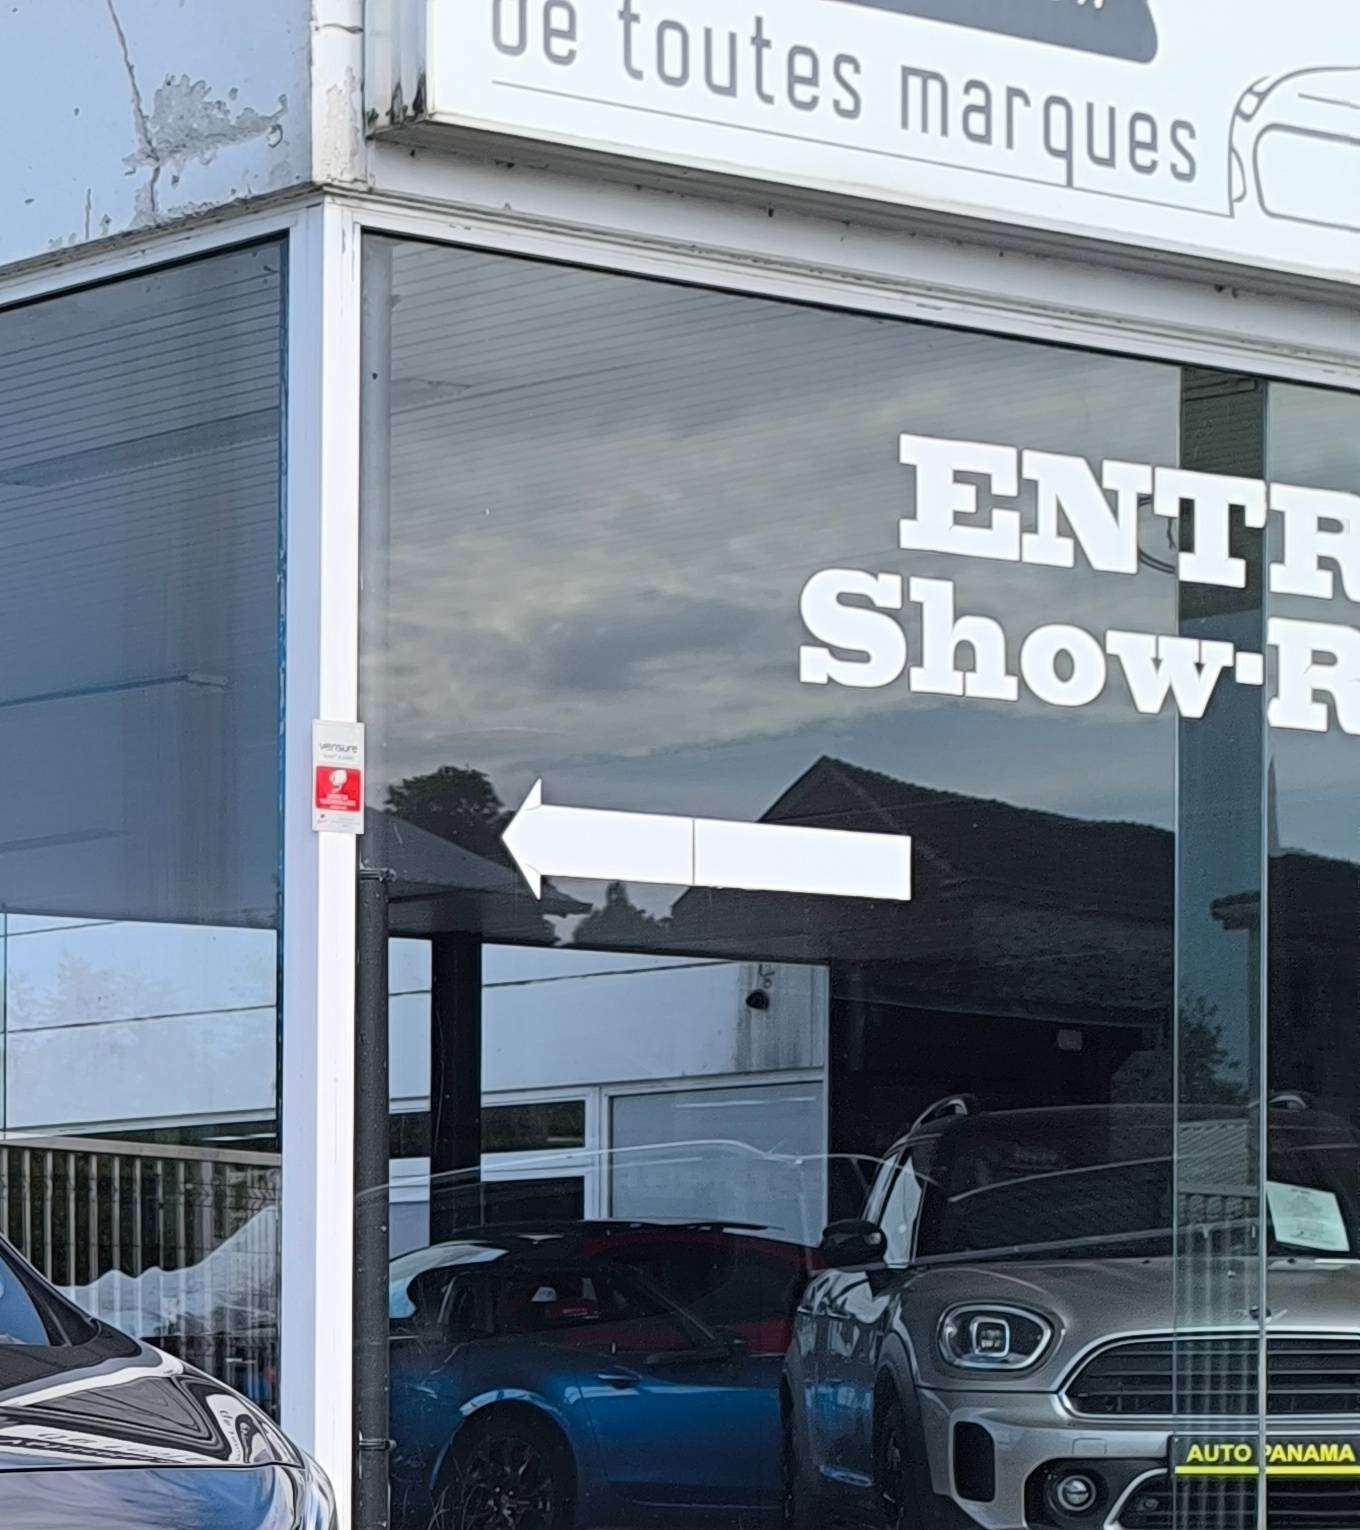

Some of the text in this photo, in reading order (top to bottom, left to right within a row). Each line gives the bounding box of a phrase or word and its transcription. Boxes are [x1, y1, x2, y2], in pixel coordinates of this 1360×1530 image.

[618, 0, 863, 121] toutes
[900, 65, 1199, 188] marques
[899, 433, 1360, 601] ENTR
[1186, 1443, 1252, 1462] AUTO
